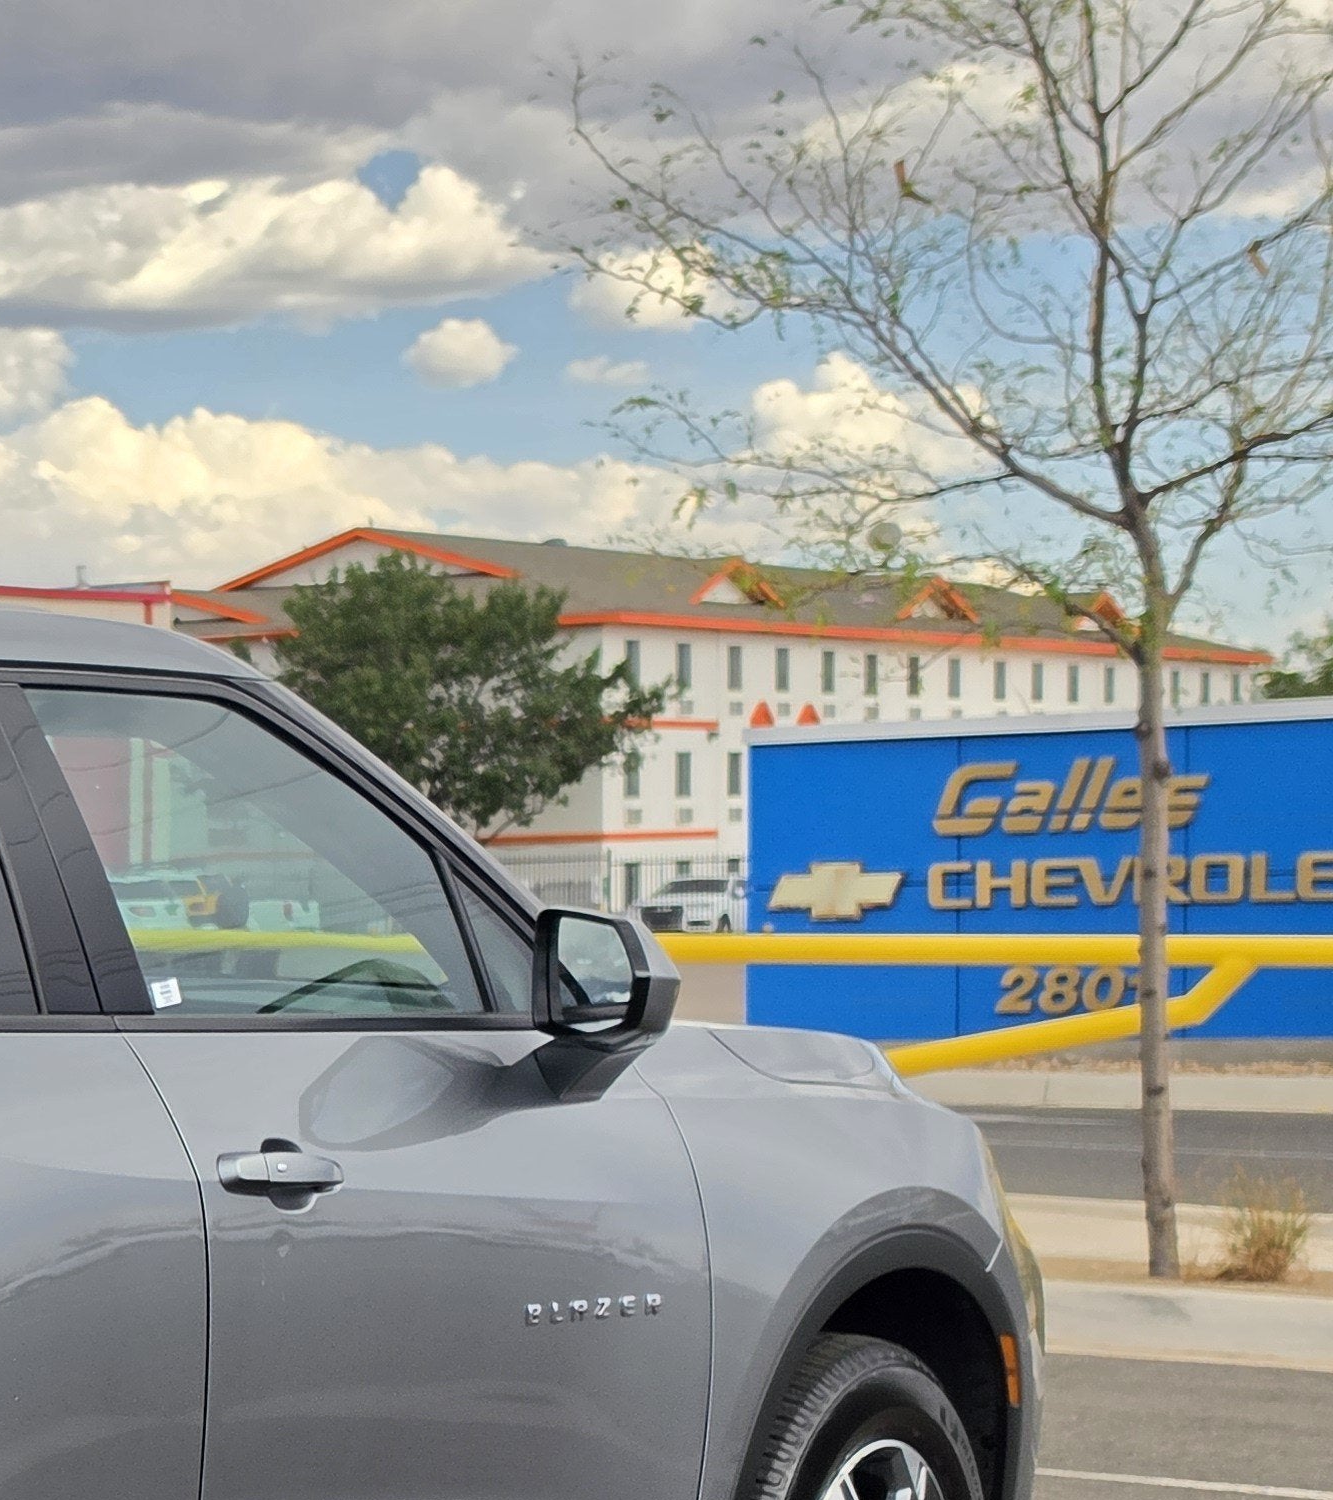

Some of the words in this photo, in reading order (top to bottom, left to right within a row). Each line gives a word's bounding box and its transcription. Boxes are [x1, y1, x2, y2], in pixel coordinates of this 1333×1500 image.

[932, 755, 1211, 837] Galles
[994, 966, 1141, 1015] 280
[525, 1293, 662, 1326] BLAZER
